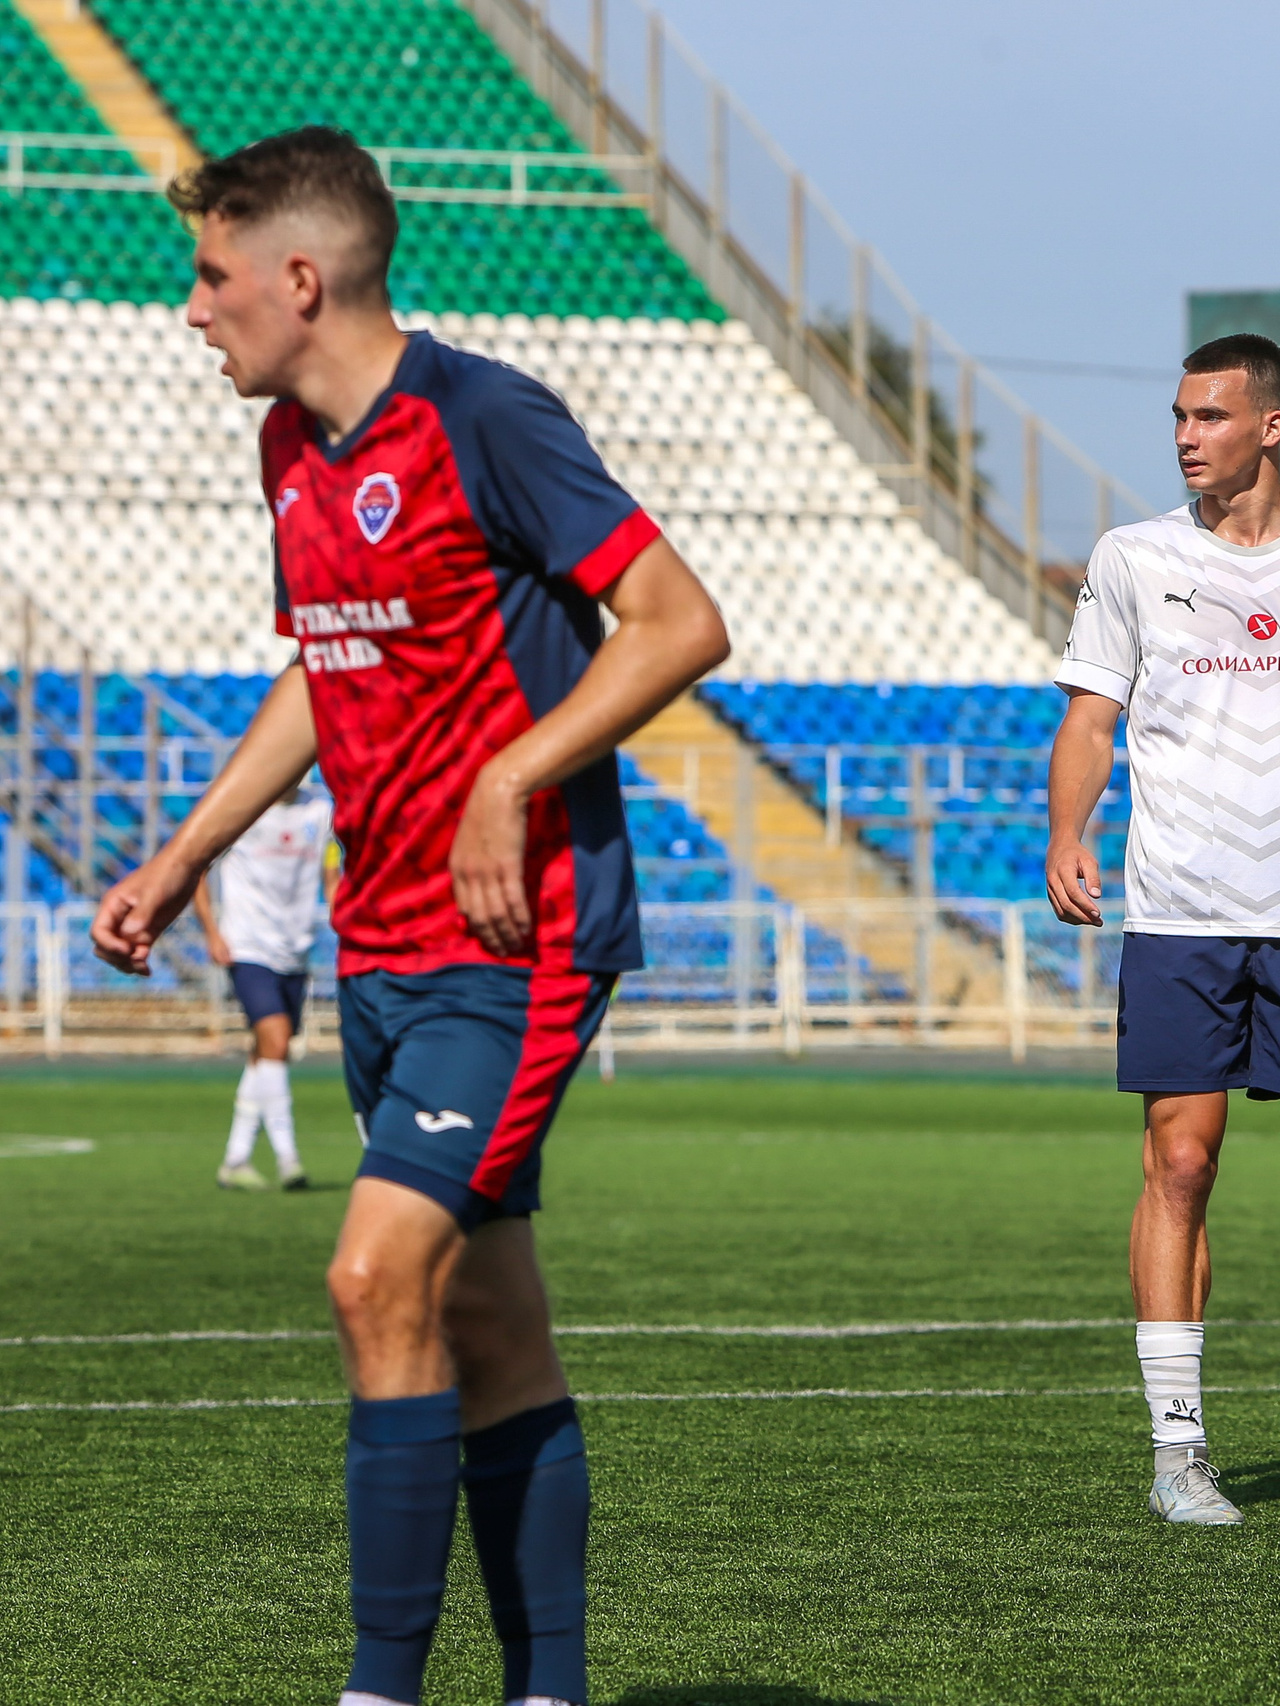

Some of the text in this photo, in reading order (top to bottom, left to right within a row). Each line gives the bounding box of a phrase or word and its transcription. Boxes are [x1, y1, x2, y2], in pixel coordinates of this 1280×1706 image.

[293, 597, 415, 636] ГИЛЬСКАЯ
[304, 636, 384, 674] СТАЛЬ
[1172, 1398, 1188, 1412] 91
